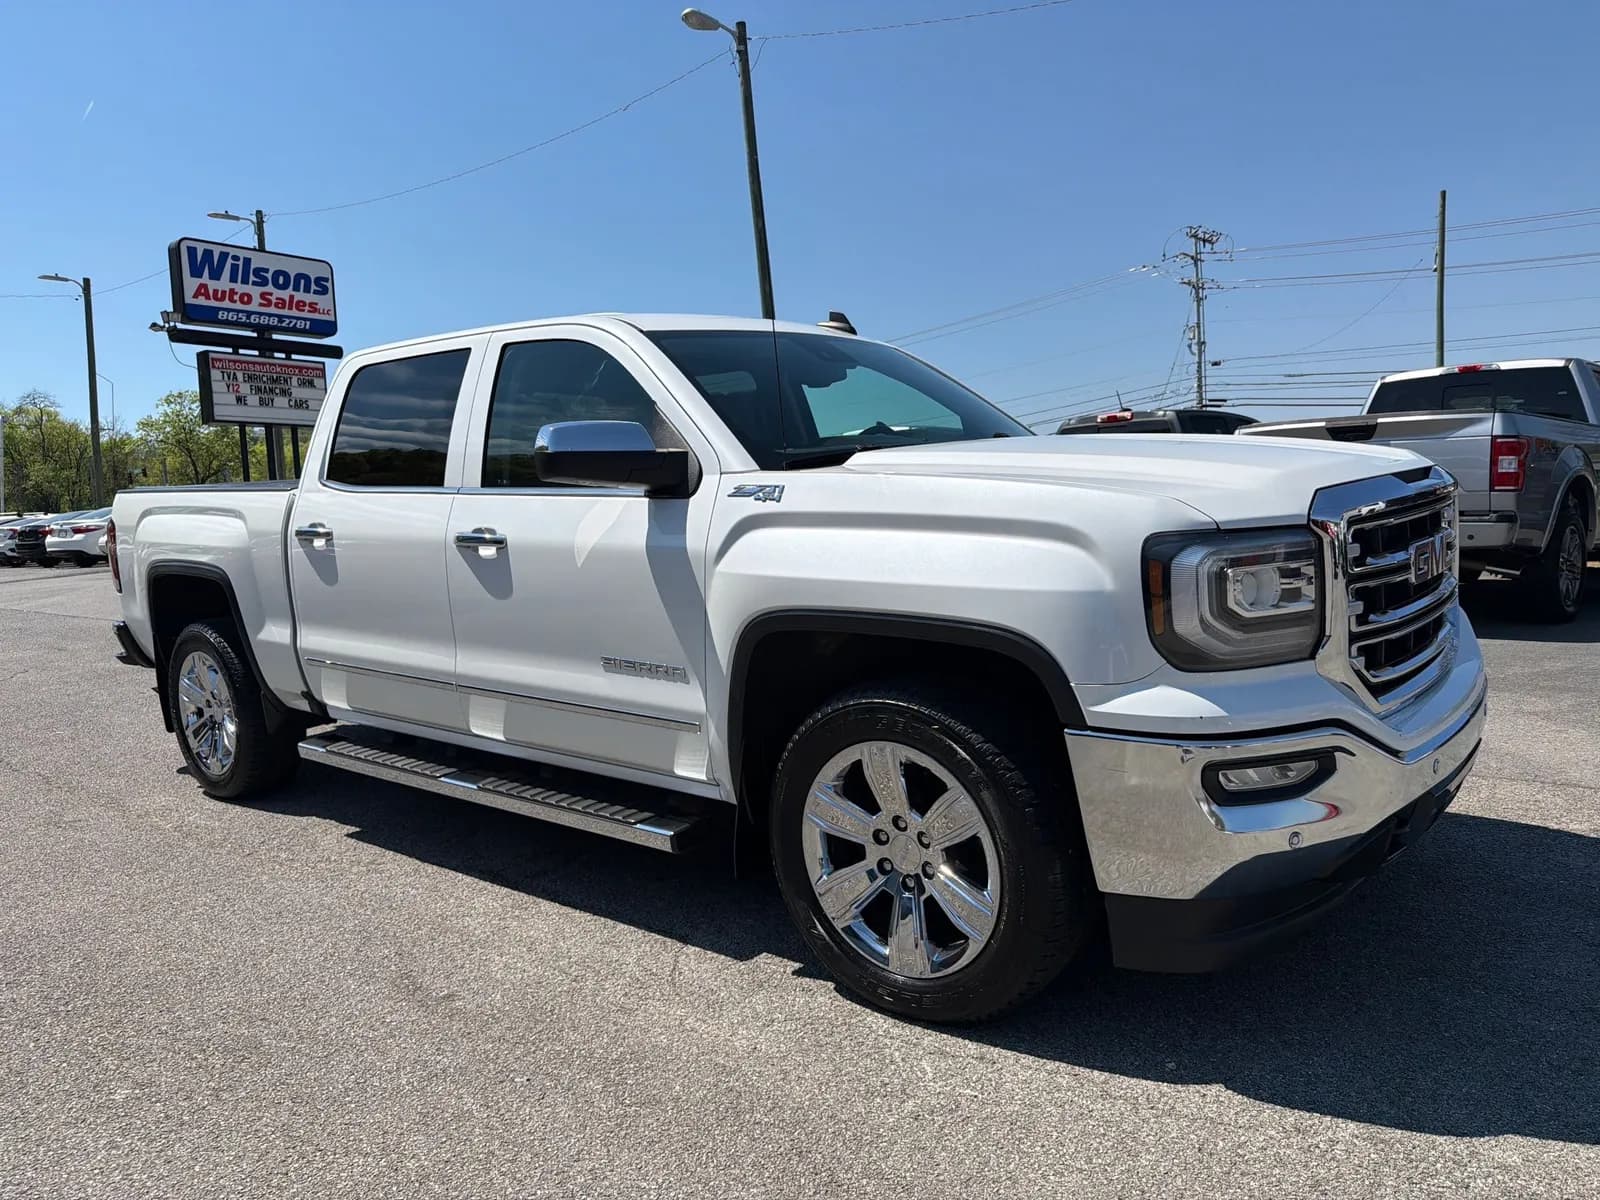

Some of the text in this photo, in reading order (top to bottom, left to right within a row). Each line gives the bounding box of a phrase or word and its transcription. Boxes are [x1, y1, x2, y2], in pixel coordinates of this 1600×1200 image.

[187, 245, 330, 296] Wilsons
[192, 283, 332, 316] Auto Sales LLC
[218, 311, 311, 330] 865.688.2781
[213, 359, 323, 377] wilsonsautoknox.com
[220, 371, 317, 388] TVA ENRICHMENT ORNL
[225, 382, 293, 397] Y12 FINANCING
[235, 395, 310, 409] WE BUY CARS
[1409, 528, 1457, 584] GMC
[600, 656, 690, 685] SIERRA
